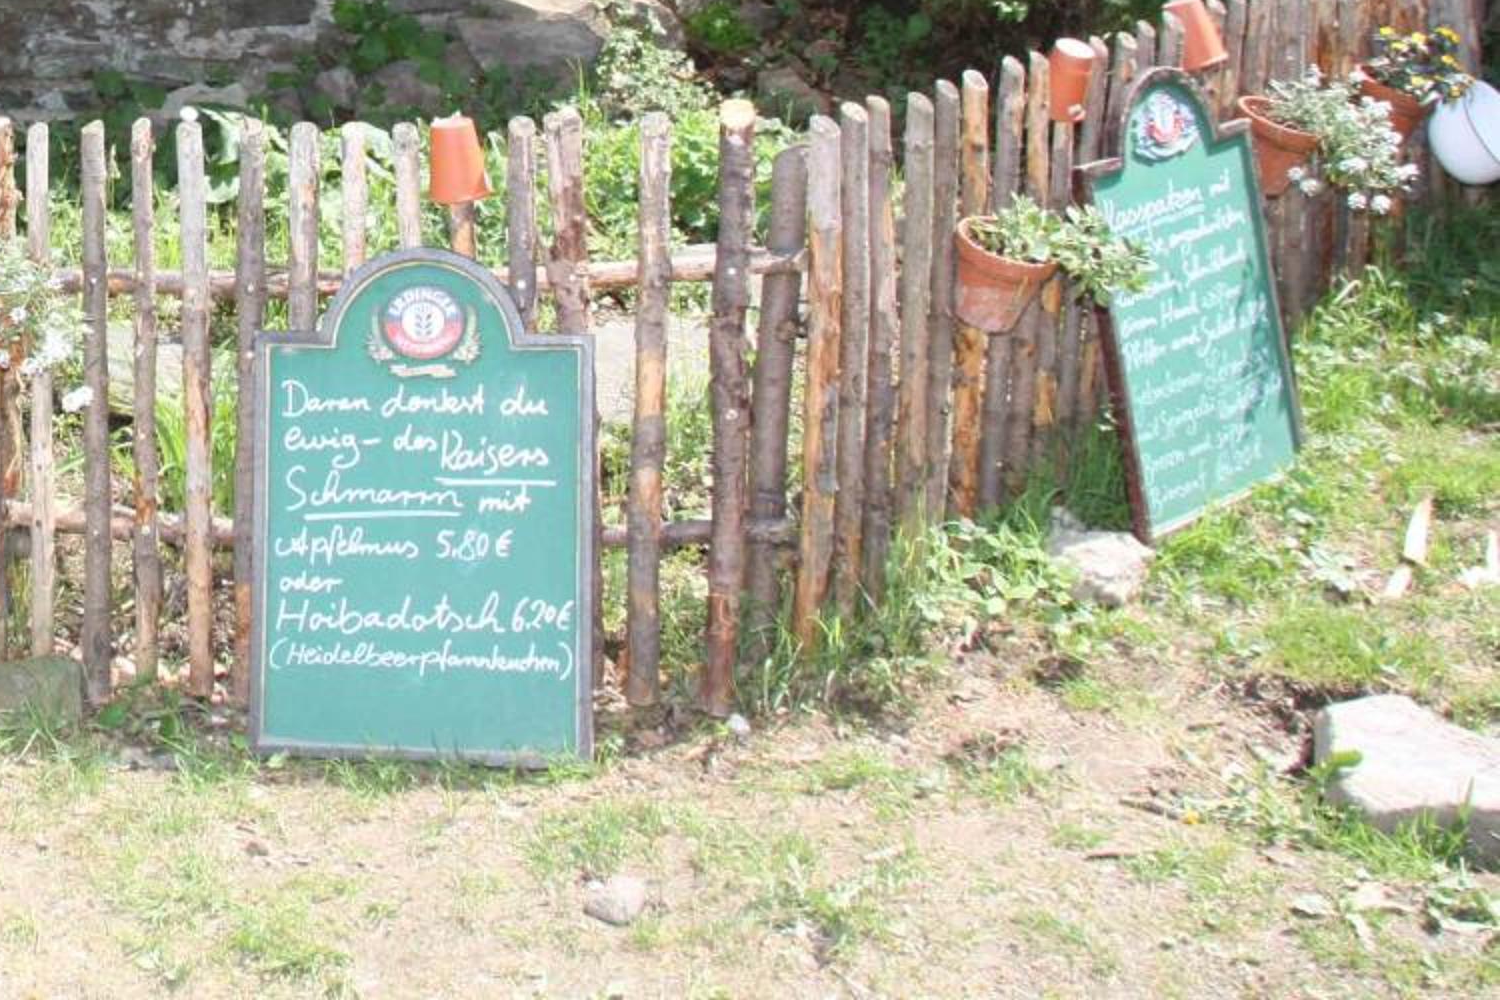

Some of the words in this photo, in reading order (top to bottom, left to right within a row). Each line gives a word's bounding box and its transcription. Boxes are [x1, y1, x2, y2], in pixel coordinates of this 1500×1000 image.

[499, 386, 549, 416] du
[440, 429, 549, 475] Kaisers
[478, 484, 531, 514] mit
[275, 524, 419, 565] Apfelmus
[280, 571, 342, 593] oder
[276, 591, 505, 635] Hoibadotsch
